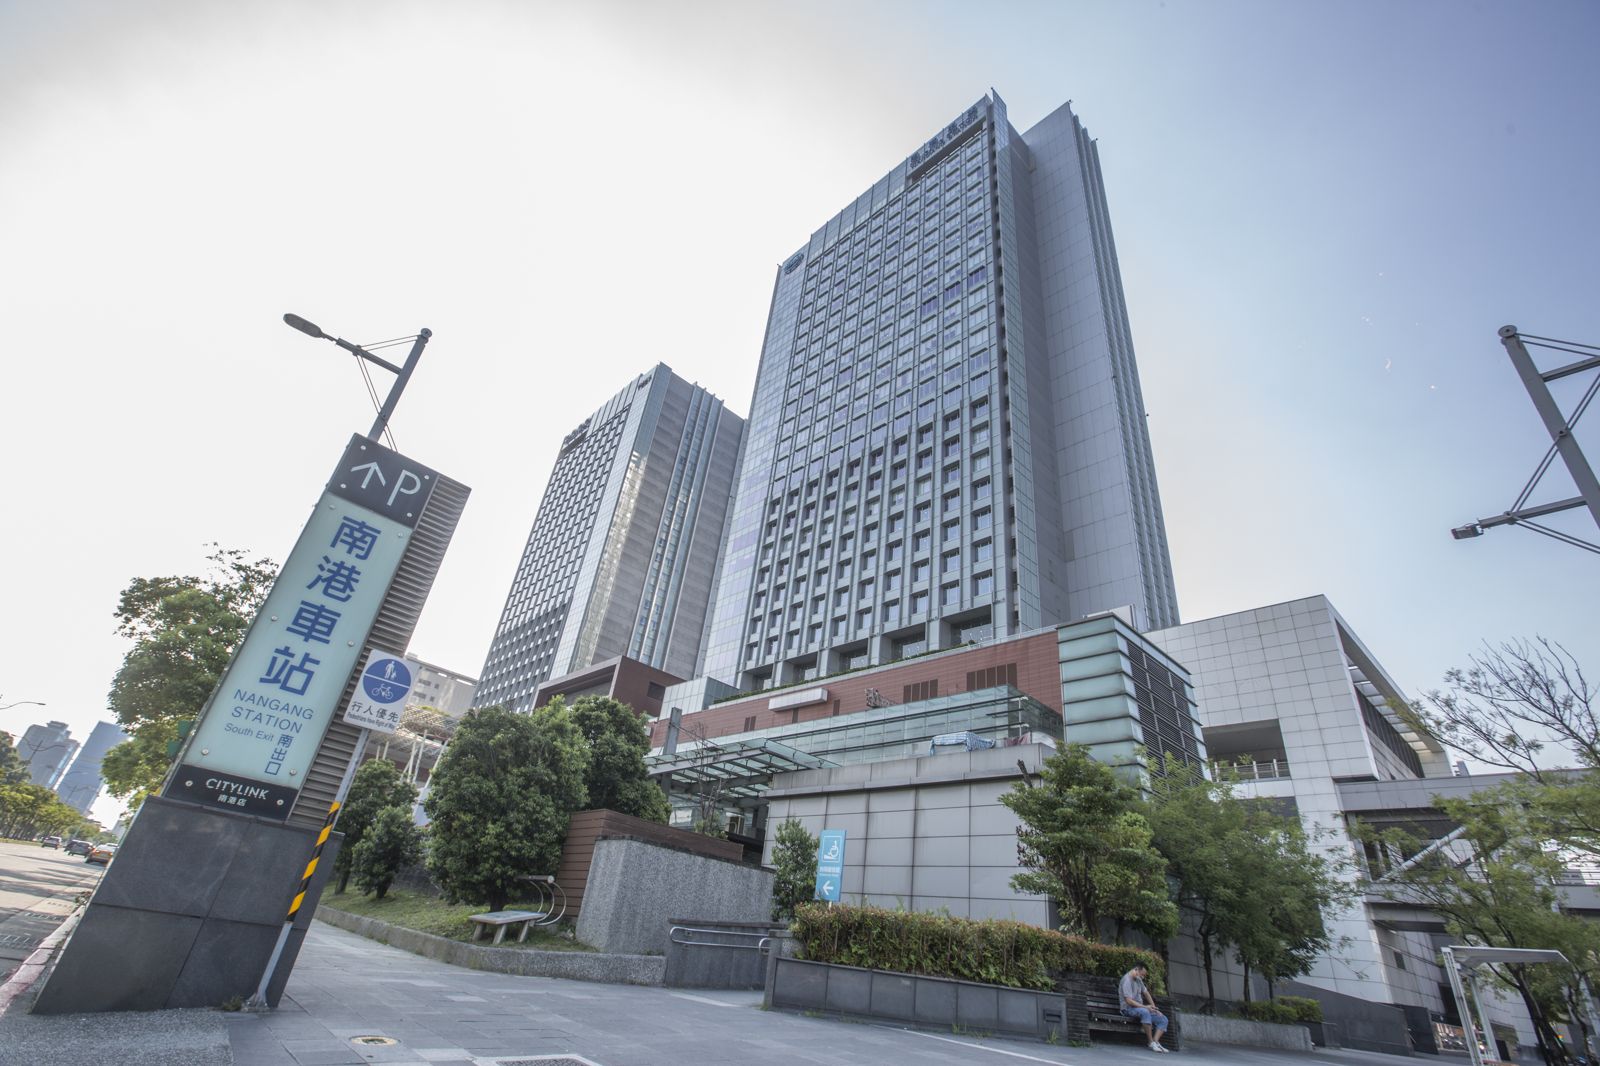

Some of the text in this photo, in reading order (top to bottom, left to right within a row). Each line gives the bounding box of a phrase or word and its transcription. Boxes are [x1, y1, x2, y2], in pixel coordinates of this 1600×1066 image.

[386, 469, 421, 506] P
[259, 516, 382, 696] 南港車站
[233, 689, 314, 720] NANGANG
[351, 701, 399, 723] 行人優先
[224, 722, 274, 742] South Exit
[231, 706, 303, 734] STATION
[264, 734, 294, 775] 南出口
[206, 778, 269, 800] CITYLINK
